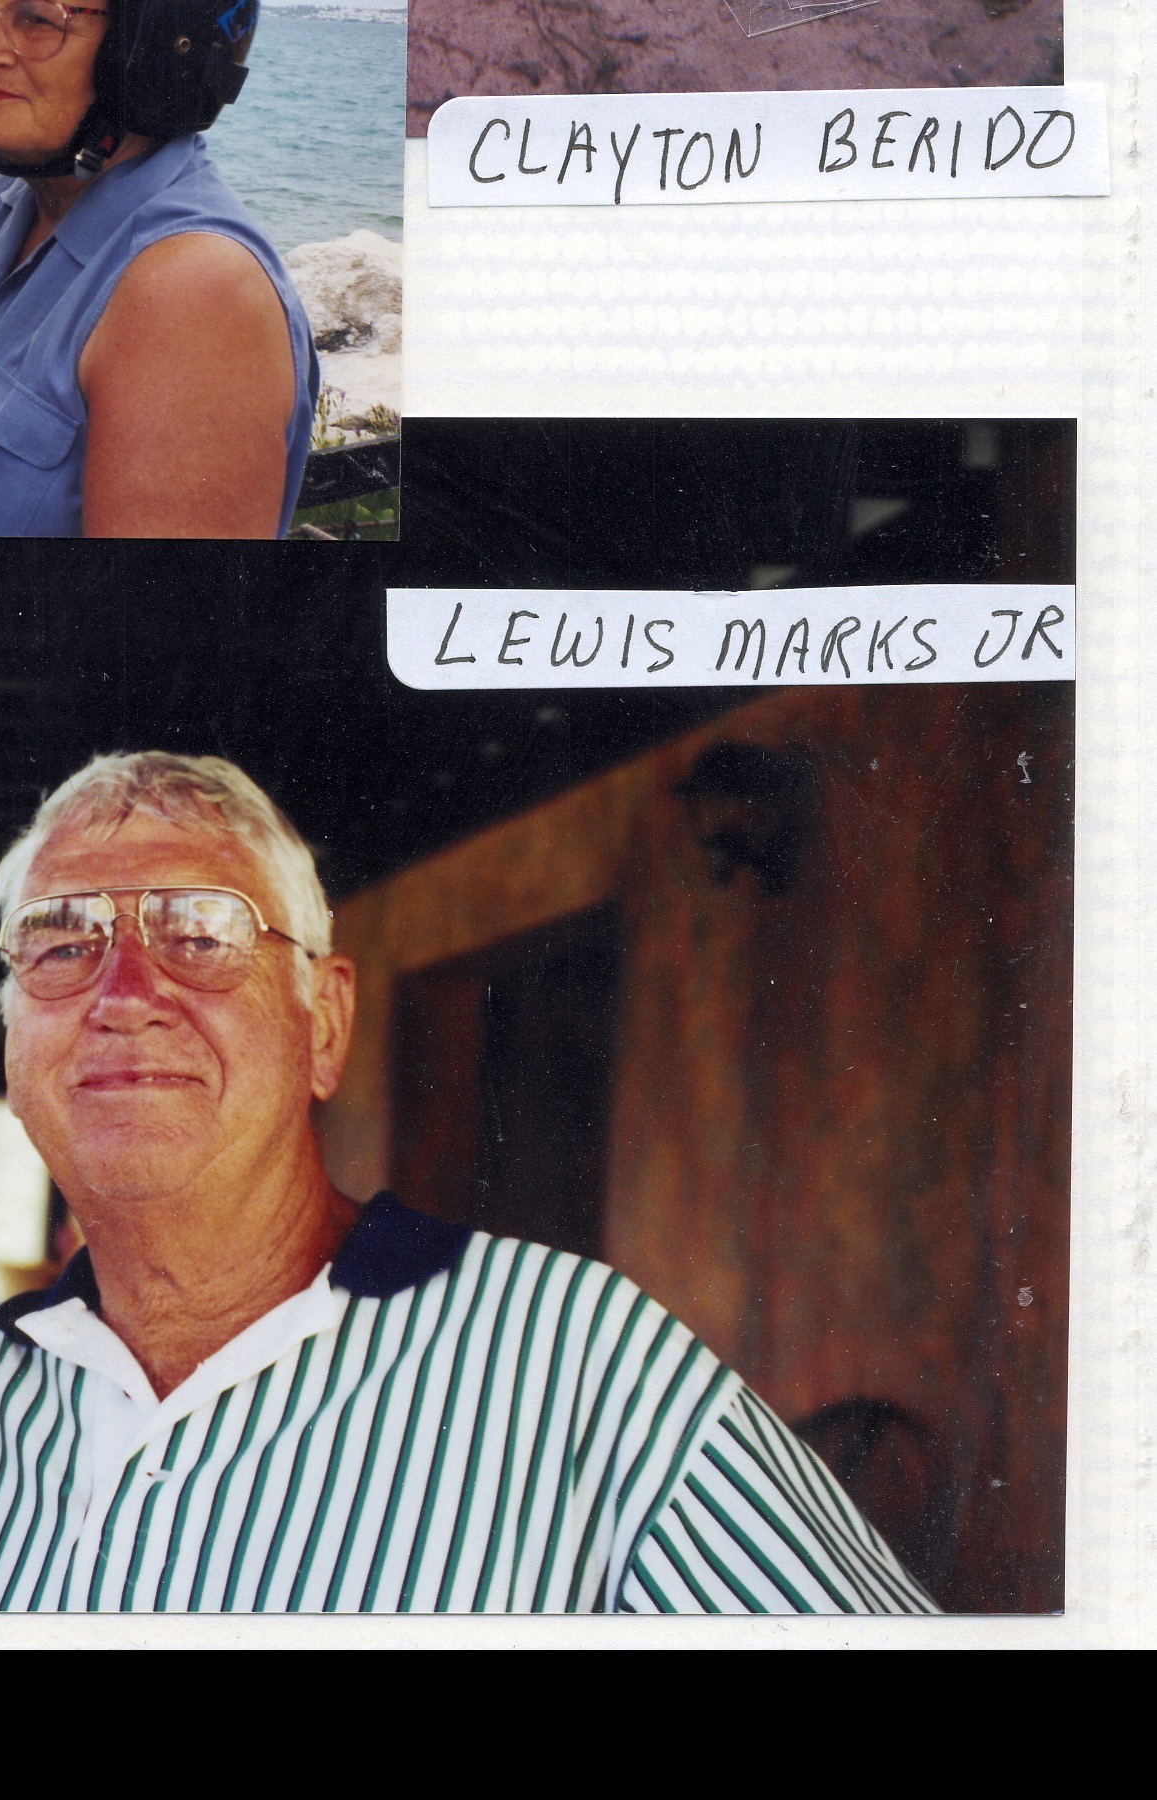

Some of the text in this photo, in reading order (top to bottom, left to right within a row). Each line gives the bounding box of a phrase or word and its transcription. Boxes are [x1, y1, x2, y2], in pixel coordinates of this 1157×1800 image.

[468, 104, 1075, 205] CLAYTON BERIDO
[434, 602, 1065, 681] LEWIS MARKS JR
